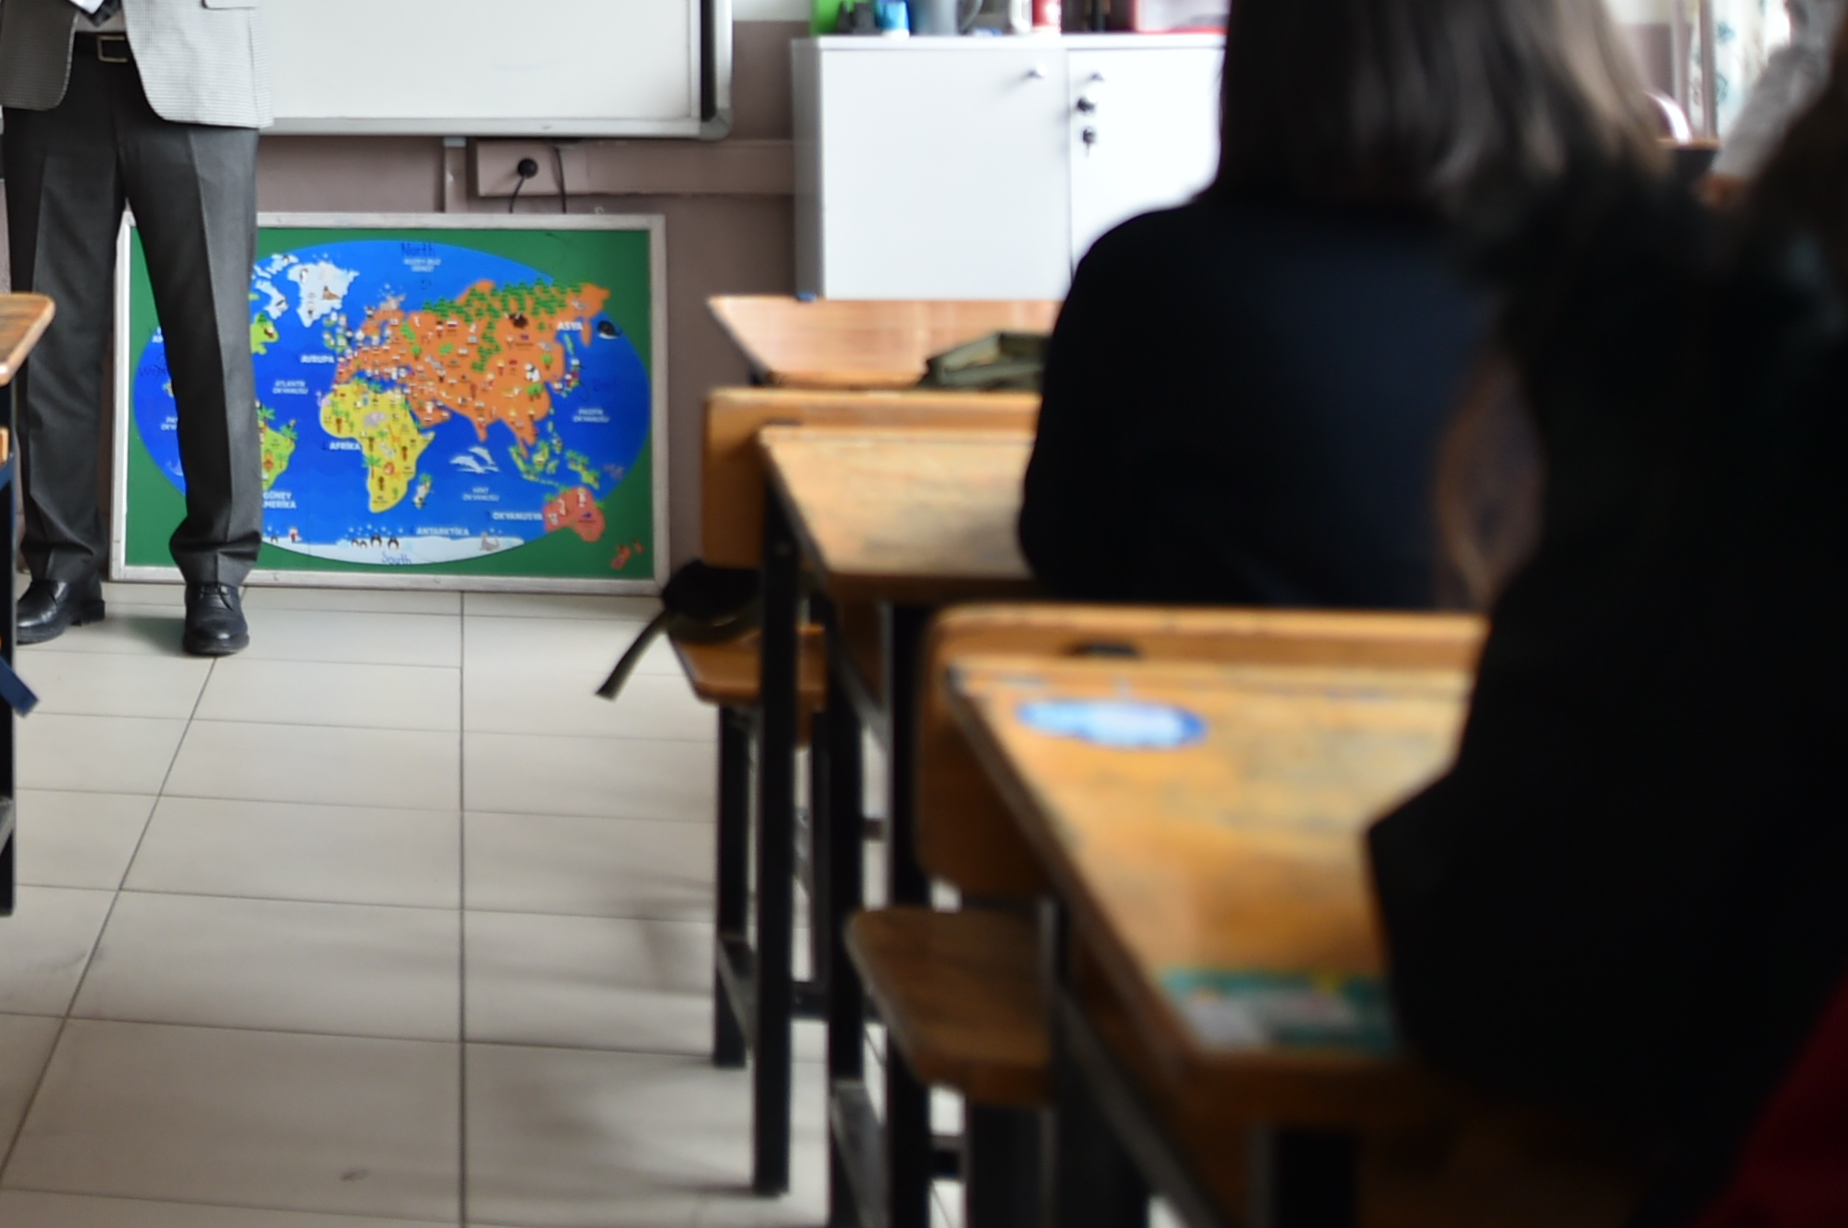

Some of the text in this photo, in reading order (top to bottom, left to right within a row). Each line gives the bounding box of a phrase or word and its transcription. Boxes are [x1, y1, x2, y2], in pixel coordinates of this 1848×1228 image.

[557, 321, 583, 331] ASYA
[262, 500, 297, 509] MERİKA
[382, 551, 412, 566] South
